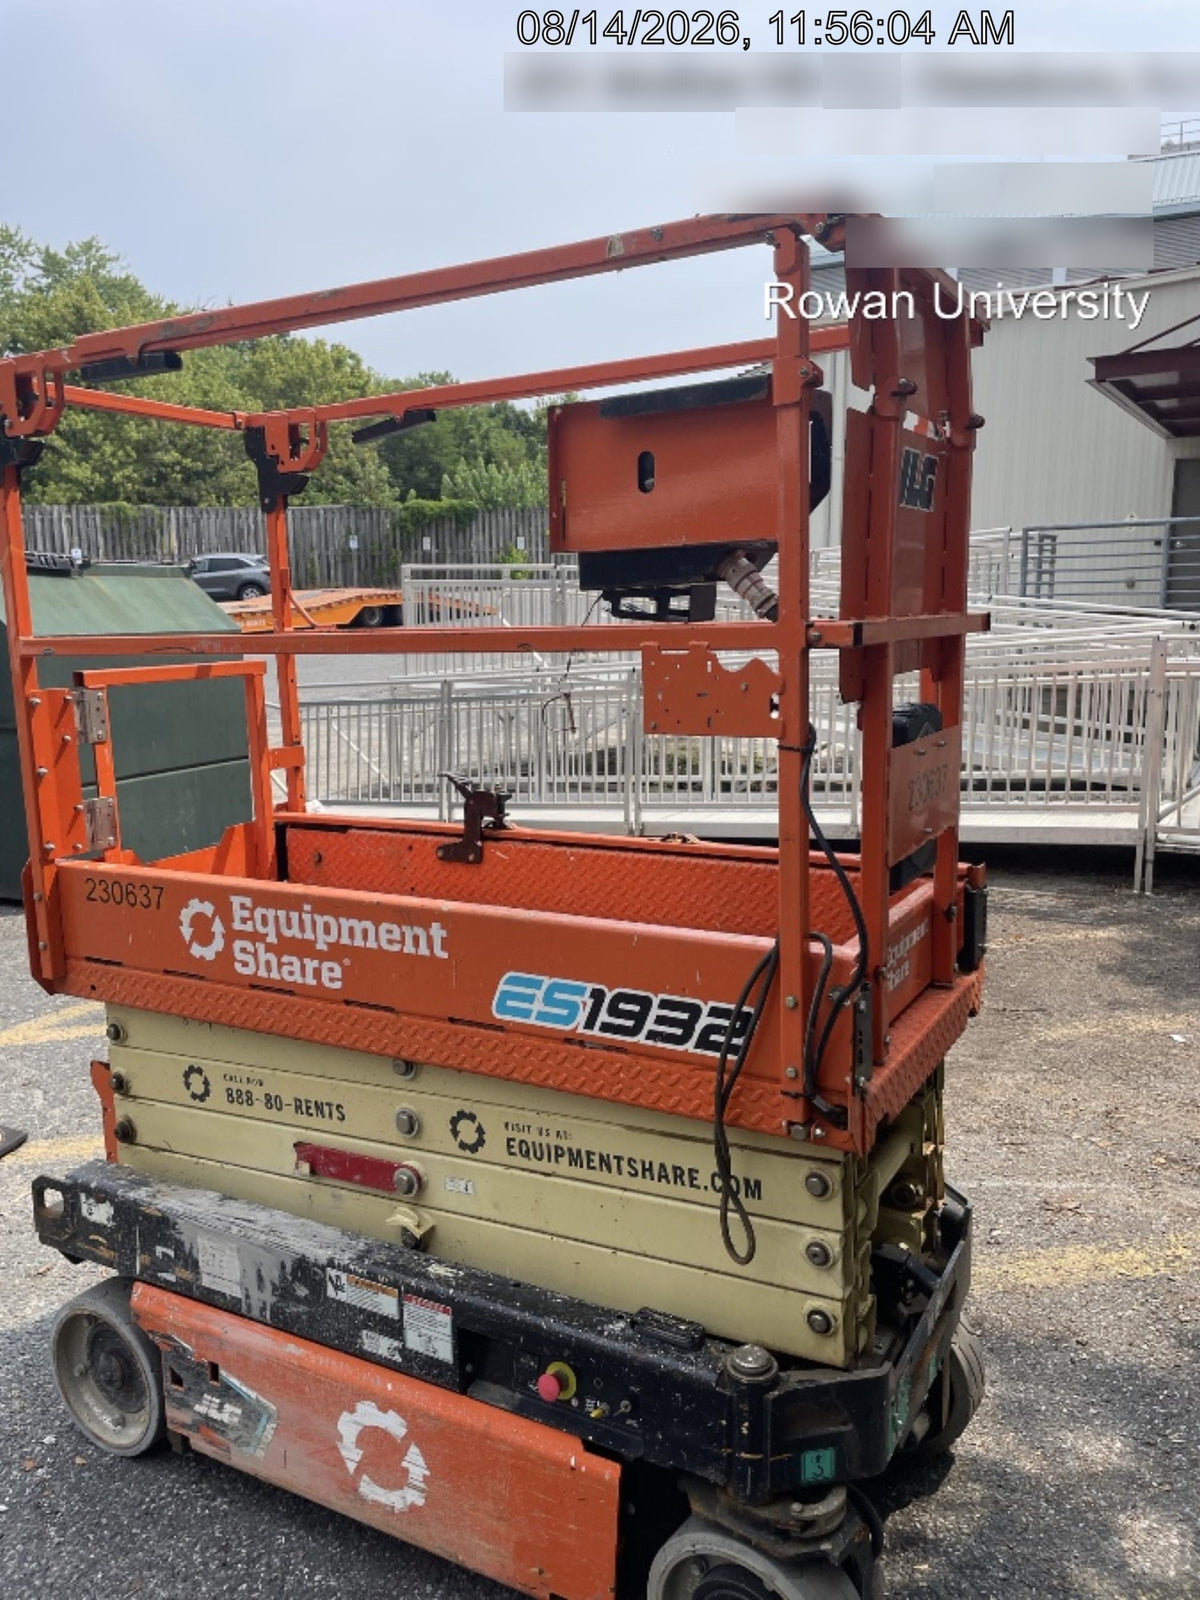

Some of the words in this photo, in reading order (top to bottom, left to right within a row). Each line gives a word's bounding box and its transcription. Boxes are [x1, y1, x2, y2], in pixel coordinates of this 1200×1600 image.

[84, 877, 165, 911] 230637
[230, 895, 449, 959] Equipment
[232, 940, 343, 990] Share
[493, 972, 754, 1060] ES1932
[225, 1087, 346, 1122] 888-80-RENTS
[506, 1137, 762, 1201] EQUIPMENTSHARE.COM
